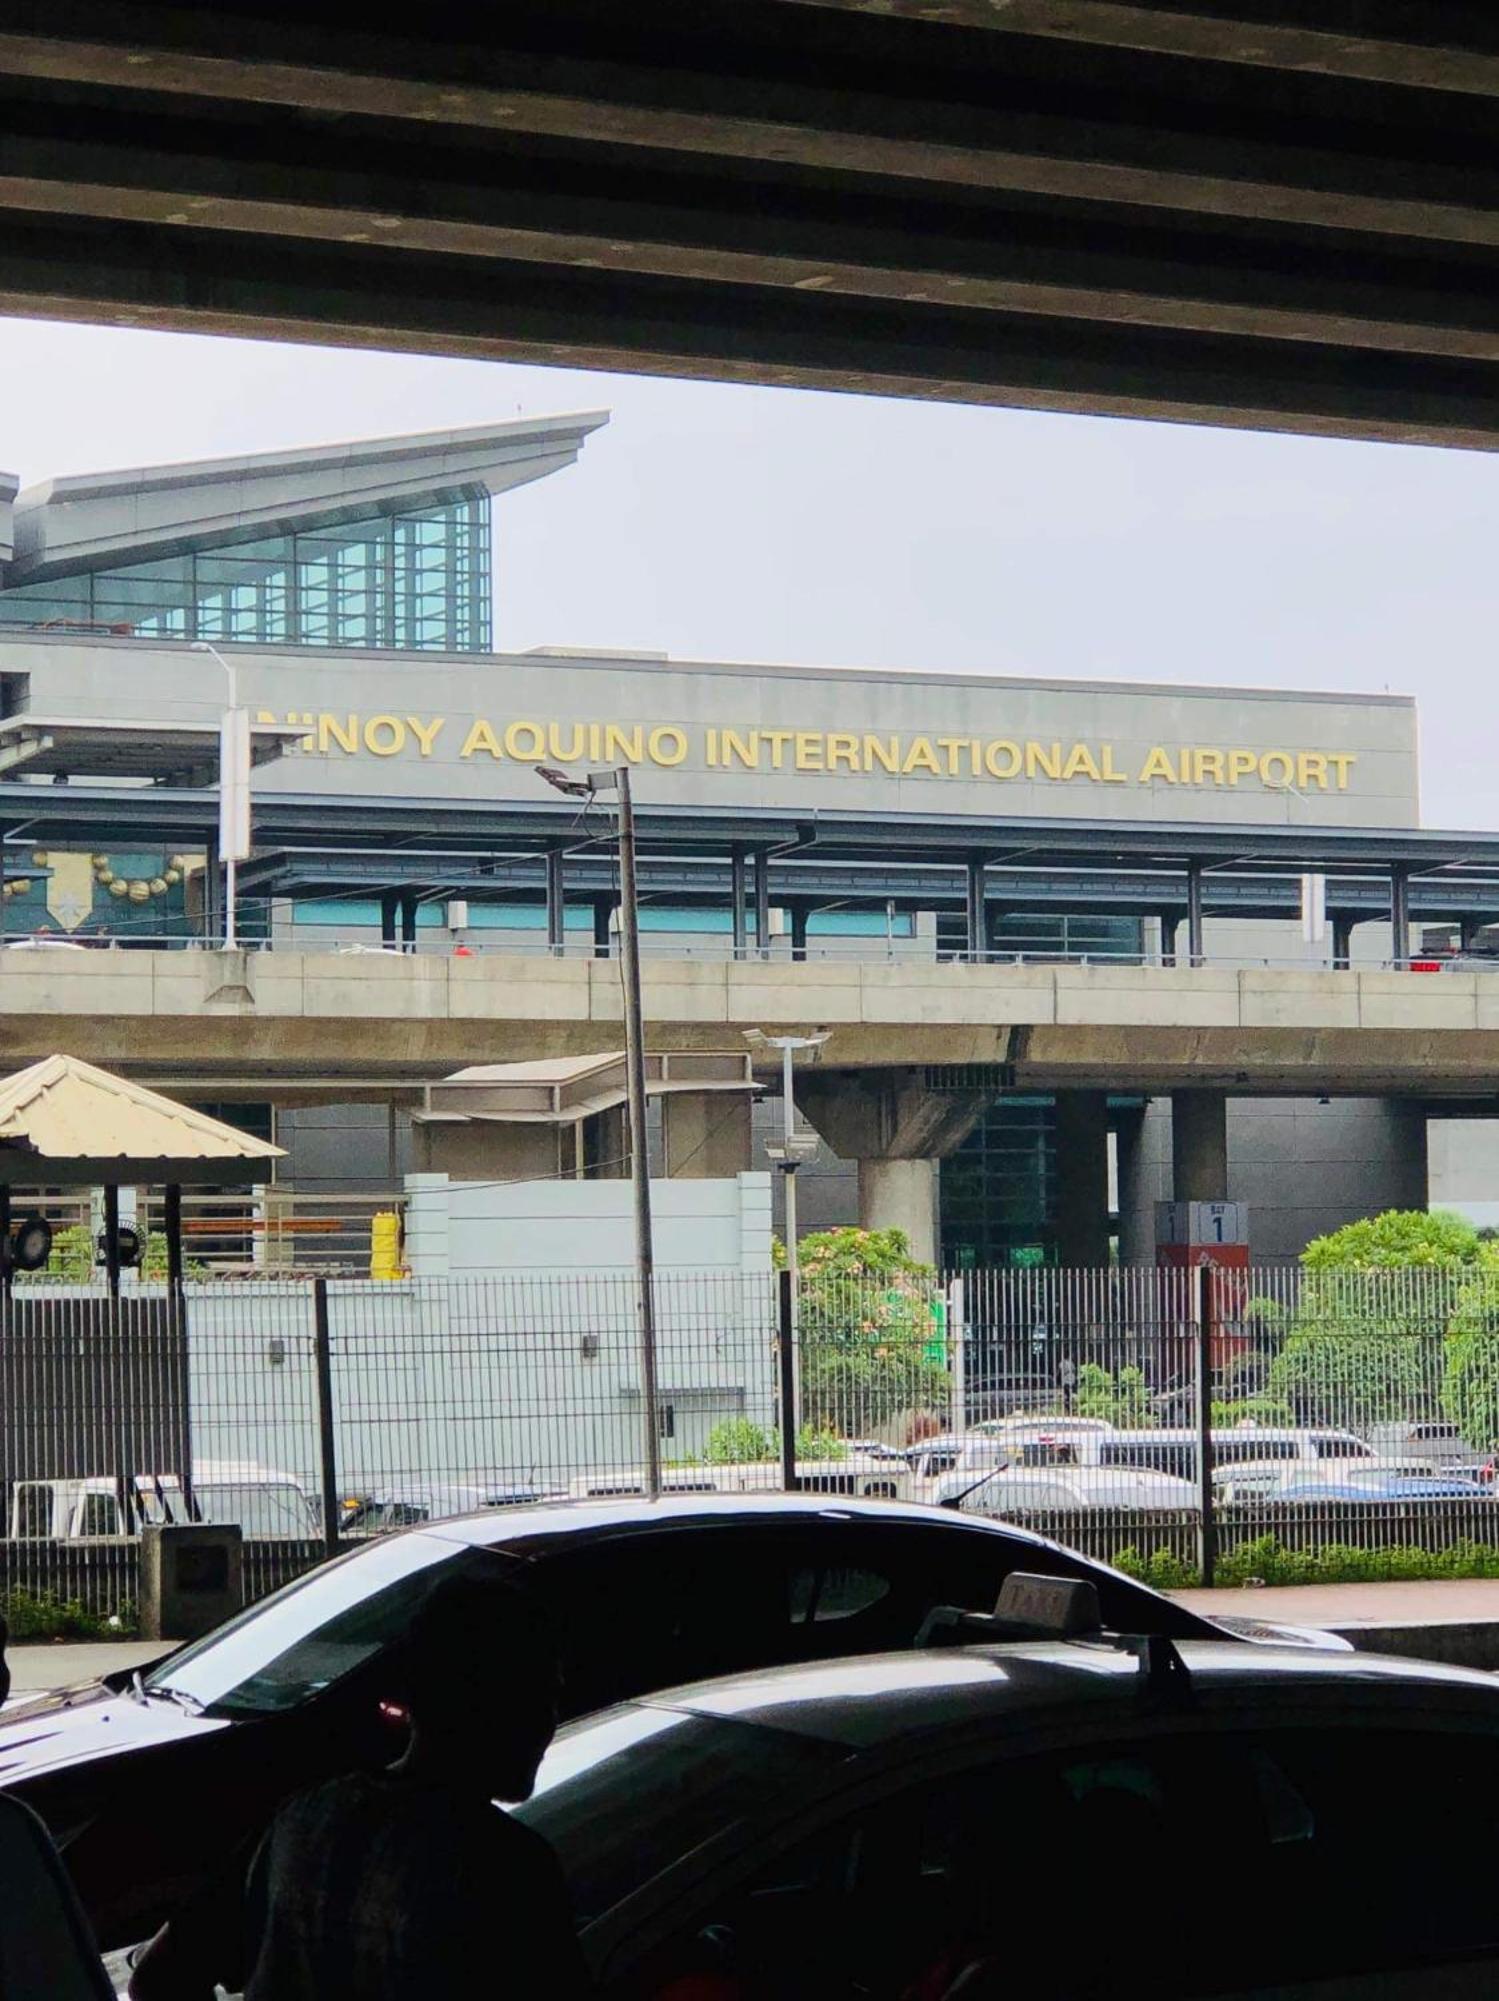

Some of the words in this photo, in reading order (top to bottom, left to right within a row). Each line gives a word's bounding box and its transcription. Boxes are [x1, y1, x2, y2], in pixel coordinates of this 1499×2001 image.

[257, 711, 445, 757] INOY
[459, 719, 688, 766] AQUINO
[706, 729, 1127, 782] INTERNATIONAL
[1138, 746, 1357, 790] AIRPORT
[1213, 1217, 1222, 1242] 1
